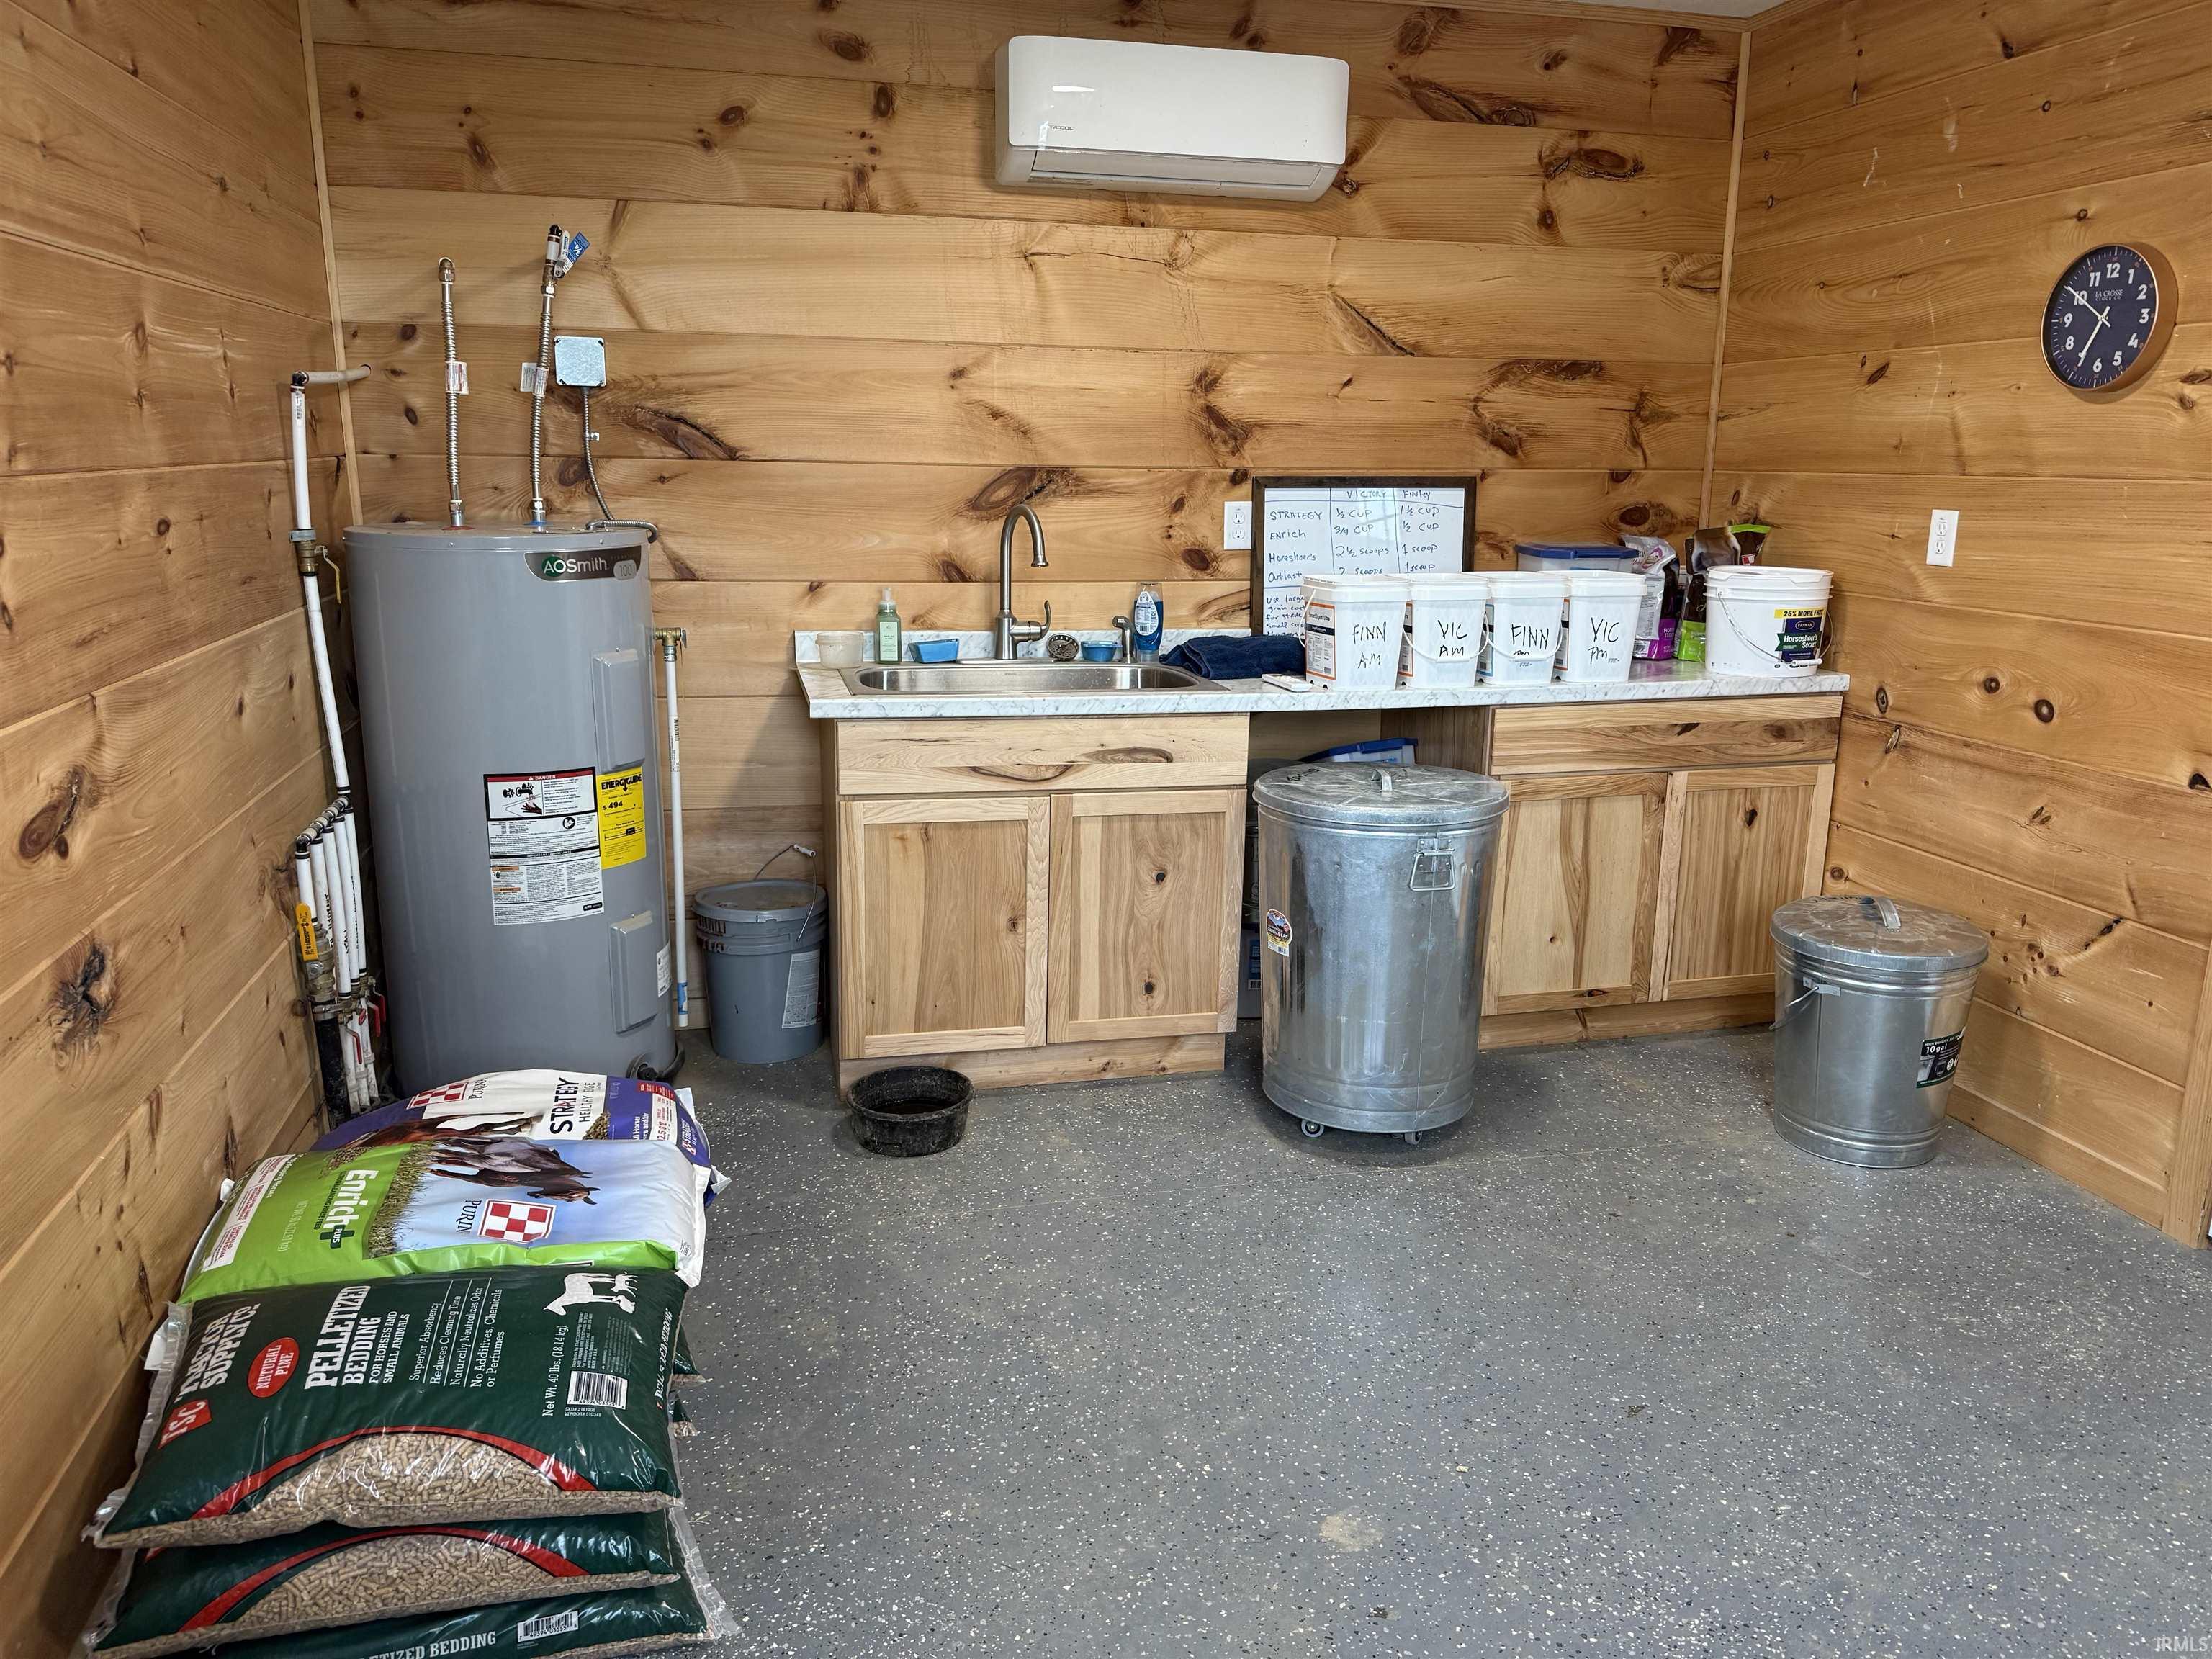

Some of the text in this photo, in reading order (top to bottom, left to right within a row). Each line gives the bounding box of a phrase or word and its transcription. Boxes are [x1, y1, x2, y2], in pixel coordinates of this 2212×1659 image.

[2090, 271, 2101, 287] 11
[2106, 262, 2121, 278] 12
[2128, 269, 2134, 284] 1
[2074, 291, 2087, 305] 10
[2136, 284, 2147, 300] 2
[2064, 313, 2073, 328] 9
[2139, 308, 2150, 324] 3
[2065, 336, 2074, 351] 8
[2128, 333, 2138, 348] 4
[2093, 357, 2103, 372] 6
[2113, 351, 2123, 366] 5
[1346, 490, 1386, 499] VICTORY
[1270, 511, 1322, 521] STRATEGY
[1349, 509, 1372, 518] CUP
[1418, 506, 1440, 517] CUP
[1334, 523, 1374, 536] 3/4 CUP
[1419, 523, 1440, 532] CUP
[1268, 570, 1302, 583] Outlast
[1352, 621, 1387, 644] FINN
[1438, 619, 1468, 640] VIC
[1511, 623, 1549, 650] FINN
[1591, 617, 1619, 642] VIC
[1784, 634, 1817, 643] Horseshoer's
[1358, 652, 1381, 669] AM
[1936, 1043, 1947, 1053] gal
[550, 1076, 581, 1135] STRATEGY
[579, 1095, 594, 1123] HEALTHY
[322, 1169, 379, 1229] Enrich
[456, 1200, 482, 1233] PURIN
[332, 1228, 343, 1244] PLUS
[304, 1285, 372, 1390] PELLETIZED
[409, 1302, 443, 1380] Superior Absorbency
[429, 1295, 462, 1385] Reduces Cleaning Time
[450, 1287, 483, 1385] Naturally Neutralizes Odor
[470, 1288, 503, 1388] No Additives, Chemicals
[199, 1319, 251, 1390] SUPPLY
[341, 1316, 382, 1385] BEDDING
[369, 1310, 397, 1384] FOR HORSES AND
[382, 1313, 410, 1384] SMALL ANIMALS
[255, 1344, 282, 1390] NATURAL
[276, 1352, 294, 1377] PINE
[485, 1331, 505, 1388] or Perfumes
[542, 1324, 570, 1417] Net Wt. 40 lbs. (18.14 kg)
[429, 1630, 496, 1658] BEDDING
